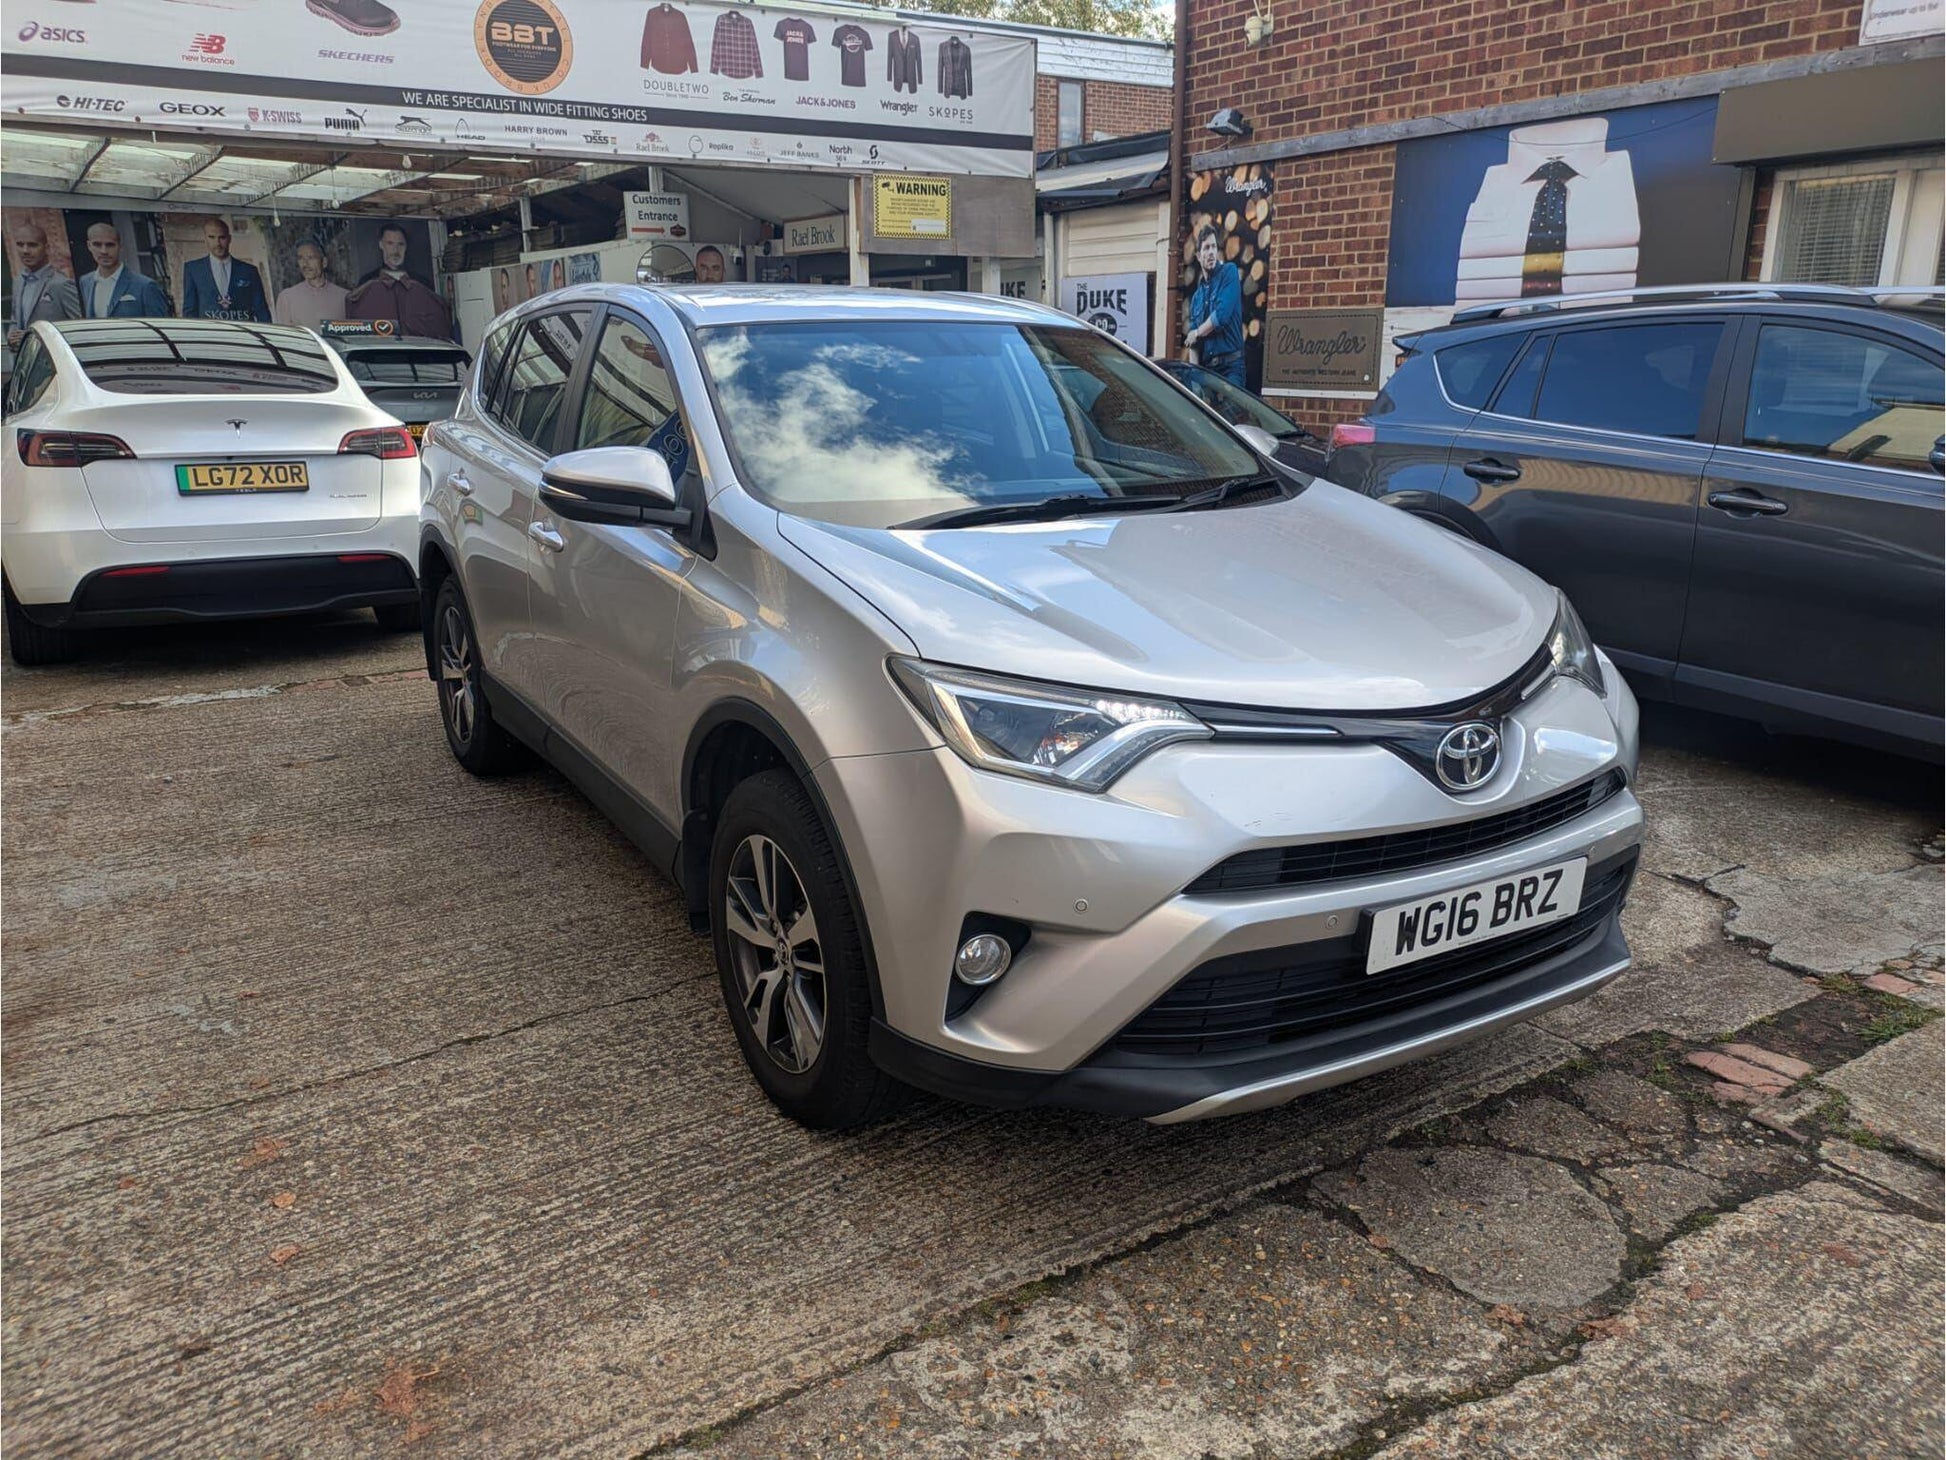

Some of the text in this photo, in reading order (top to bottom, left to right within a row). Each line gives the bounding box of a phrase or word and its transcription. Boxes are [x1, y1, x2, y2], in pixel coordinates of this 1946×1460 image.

[491, 22, 555, 45] BBT
[181, 54, 235, 66] new balance
[318, 49, 395, 64] SKECHERS
[643, 79, 709, 94] DOUBLETWO
[722, 91, 739, 101] Ben
[740, 93, 776, 105] Sherman
[159, 101, 226, 117] GEOX
[402, 91, 648, 122] WE ARE SPECIALIST IN WIDE FITTING SHOES
[879, 99, 919, 116] Wrangler
[928, 106, 974, 119] SKOPES
[504, 125, 568, 136] HARRY BROWN
[828, 145, 853, 155] North
[896, 182, 946, 197] WARNING
[1225, 175, 1267, 197] Wrangler
[632, 194, 681, 206] Customers
[638, 210, 679, 222] Entrance
[791, 224, 836, 247] Rael Brook
[1076, 282, 1088, 290] THE
[1076, 288, 1127, 317] DUKE
[204, 310, 250, 321] SKOPES
[328, 322, 372, 334] Approved
[1277, 325, 1366, 365] Wrangler
[192, 464, 304, 487] LG72 XOR
[1395, 869, 1565, 956] WG16 BRZ
